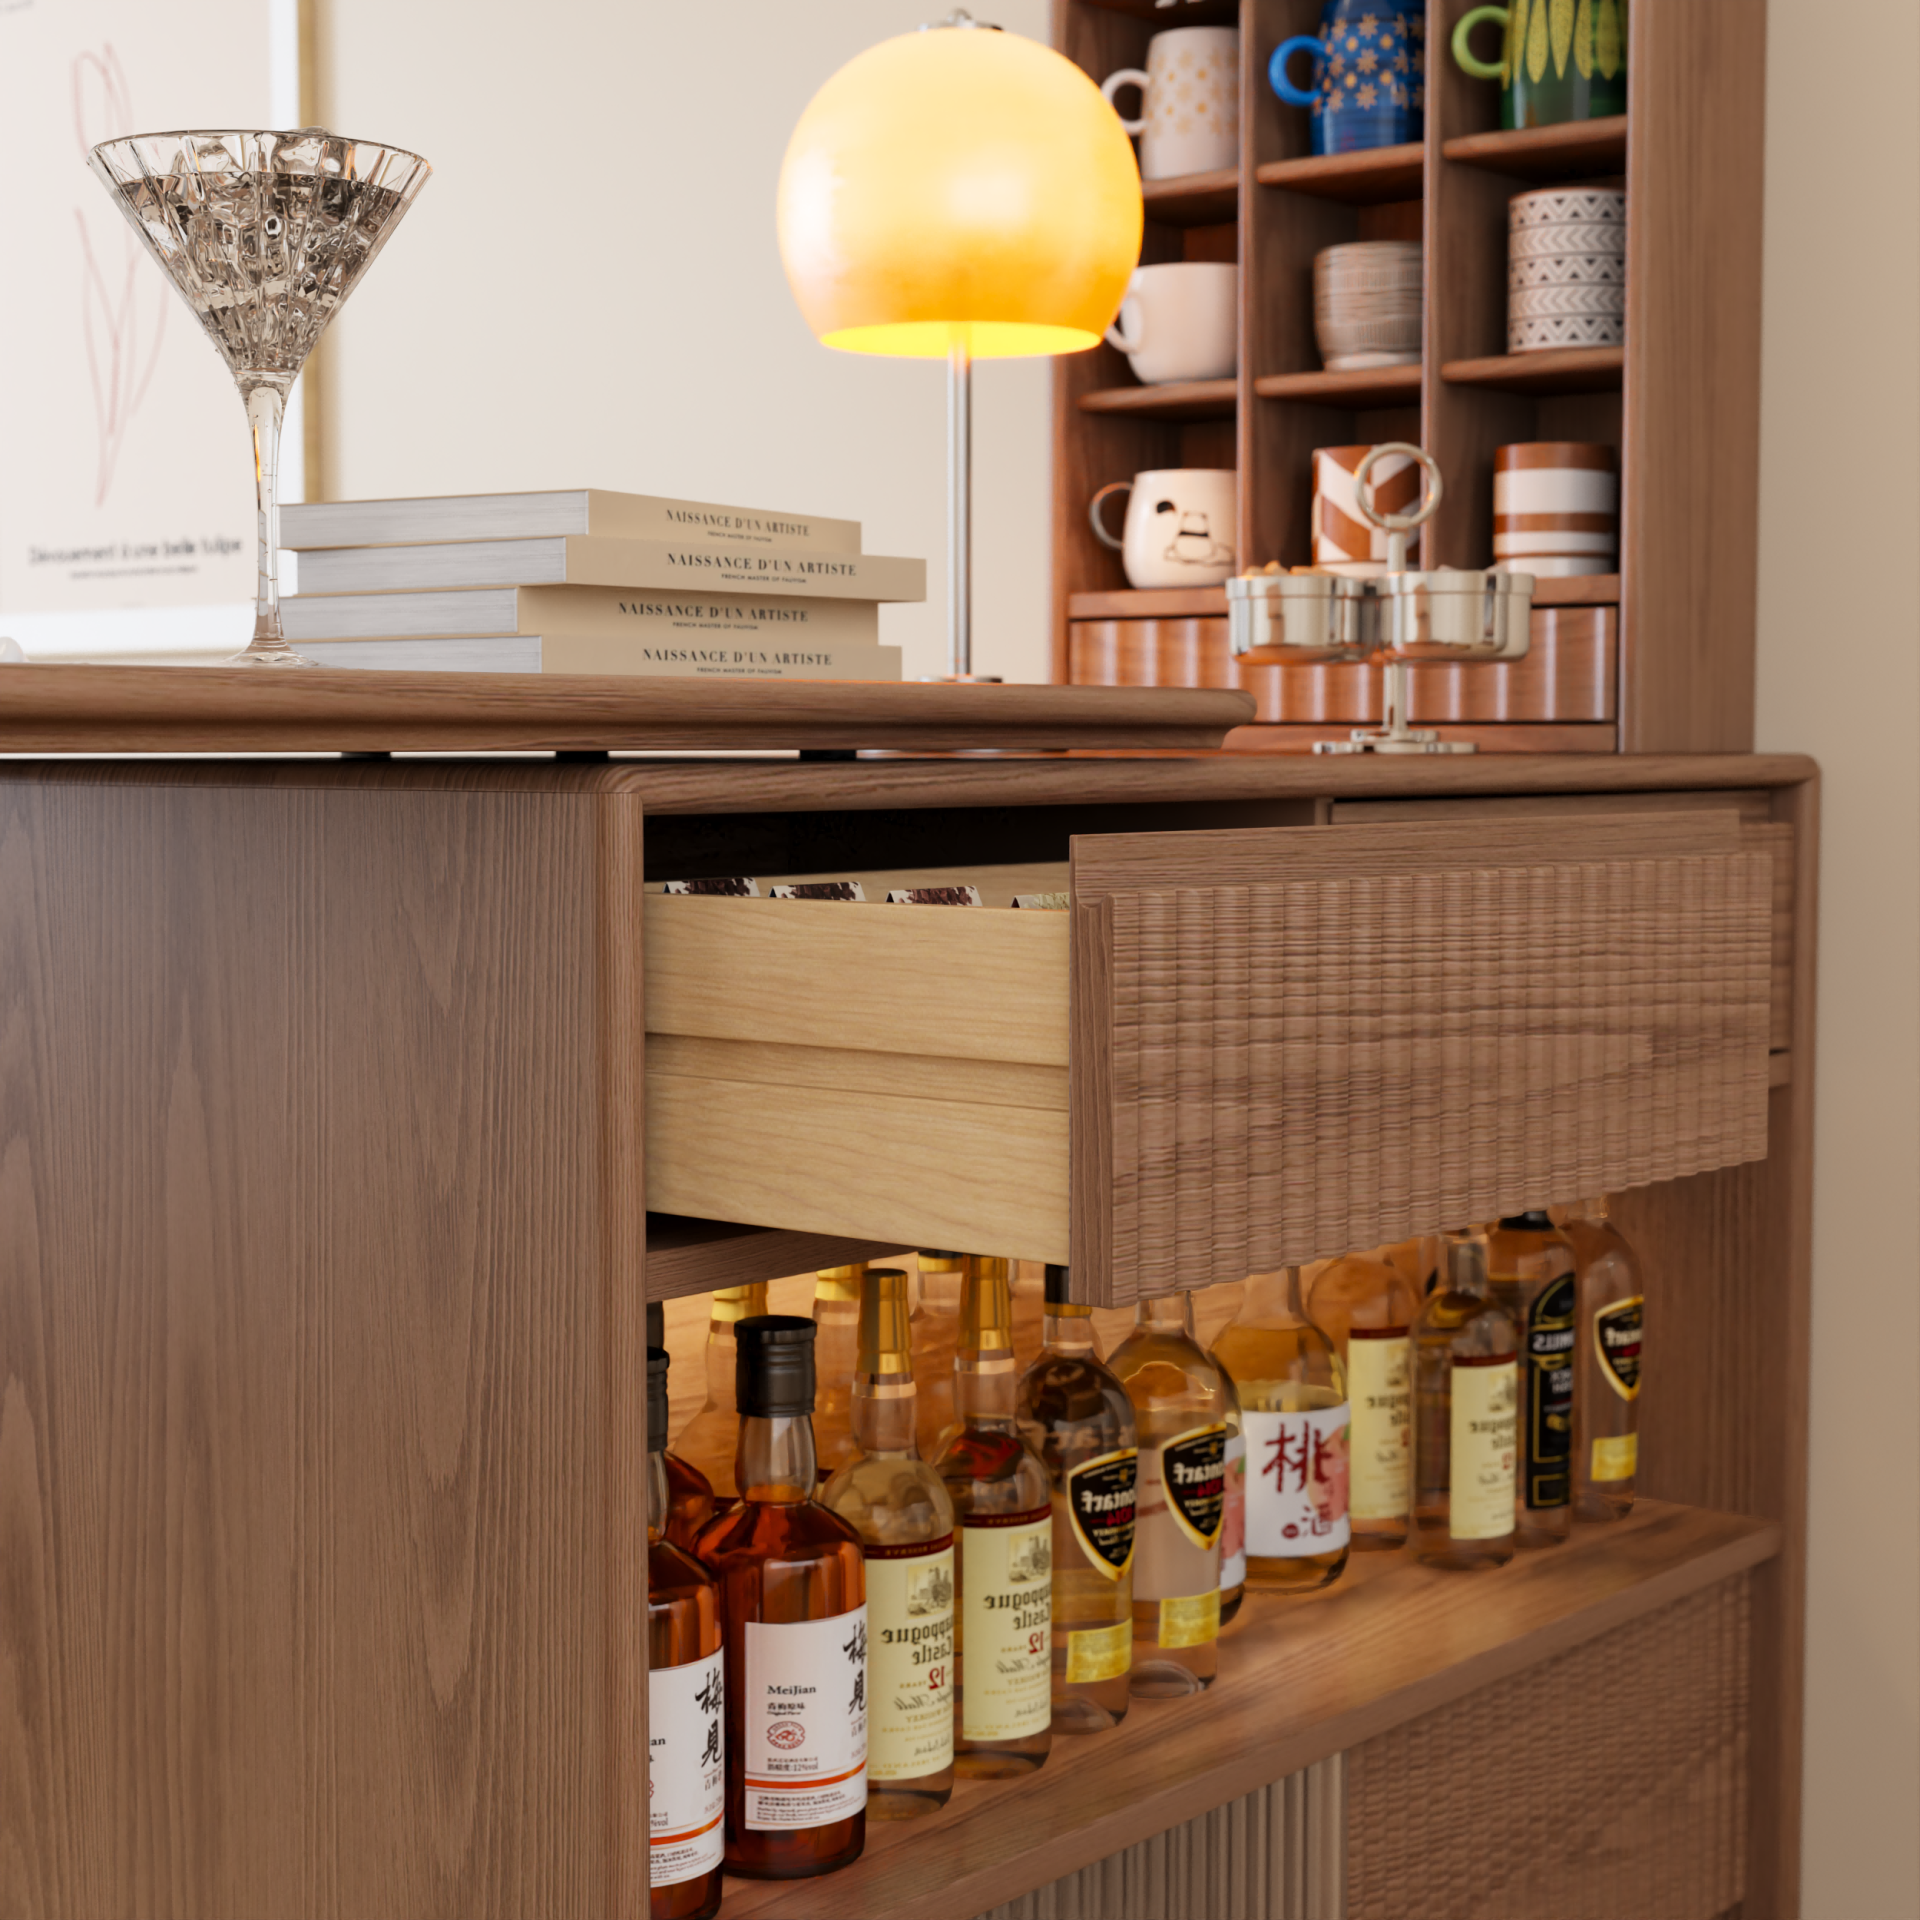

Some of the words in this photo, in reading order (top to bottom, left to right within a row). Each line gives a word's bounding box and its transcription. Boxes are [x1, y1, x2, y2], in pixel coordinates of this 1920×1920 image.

[666, 509, 731, 528] NAISSANCE
[735, 517, 761, 531] D'UN
[766, 520, 809, 537] ARTISTE
[667, 553, 752, 569] NAISSANCE
[758, 558, 792, 572] D'UN
[797, 561, 857, 577] ARTISTE
[721, 573, 745, 581] FRENCH
[618, 602, 703, 618] NAISSANCE
[709, 606, 743, 619] D'UN
[748, 608, 809, 622] ARTISTE
[642, 648, 728, 663] NAISSANCE
[733, 651, 767, 663] D'UN
[772, 653, 832, 666] ARTISTE
[767, 1685, 817, 1696] MeiJian
